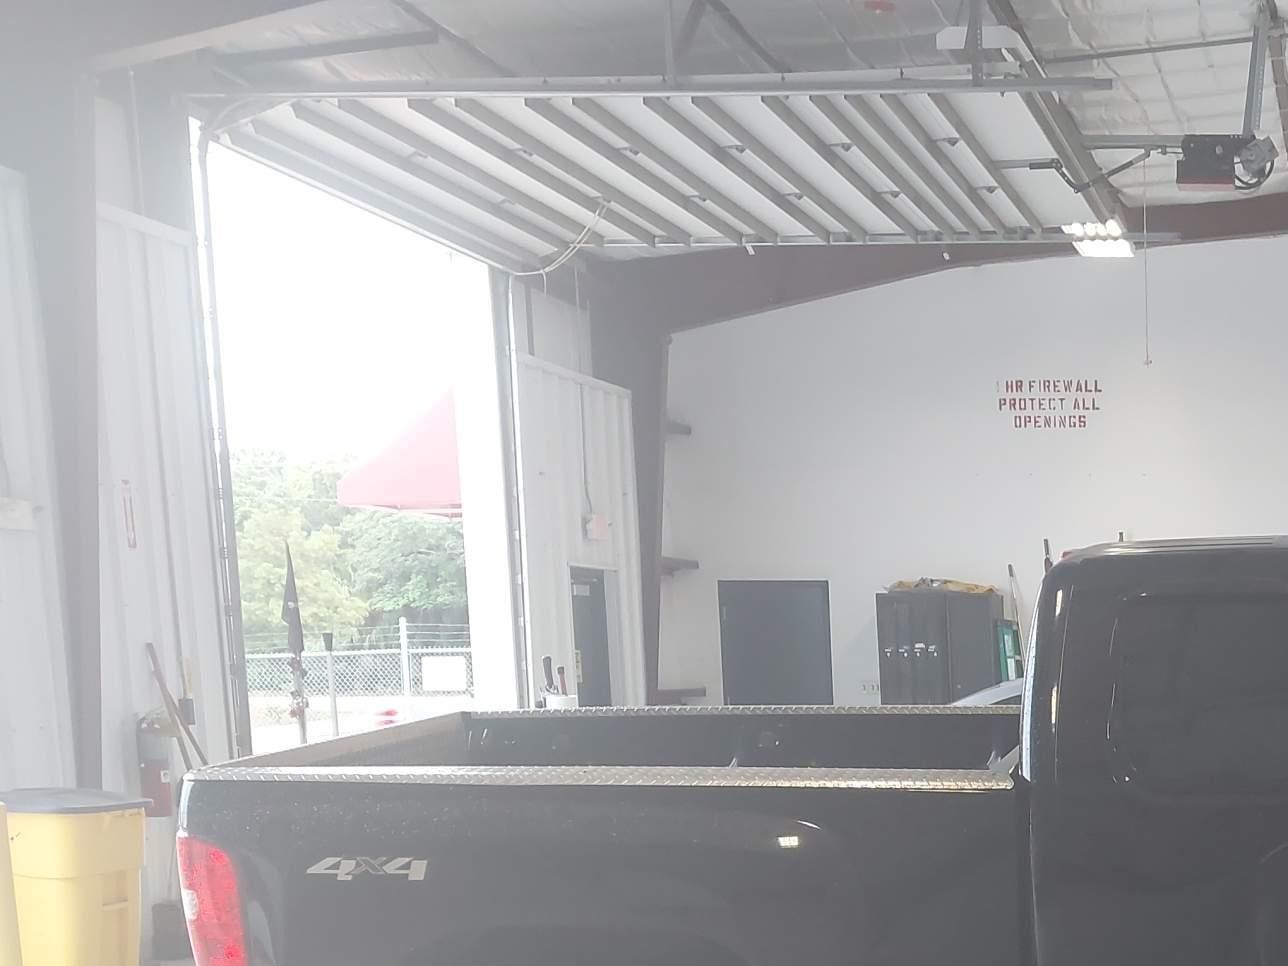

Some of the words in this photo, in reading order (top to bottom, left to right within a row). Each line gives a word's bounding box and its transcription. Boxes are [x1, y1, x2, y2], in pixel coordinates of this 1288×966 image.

[1006, 379, 1023, 393] HR
[1028, 379, 1102, 393] FIREWALL
[999, 398, 1066, 411] PROTECT
[1073, 397, 1100, 411] ALL
[1014, 415, 1087, 428] OPENINGS
